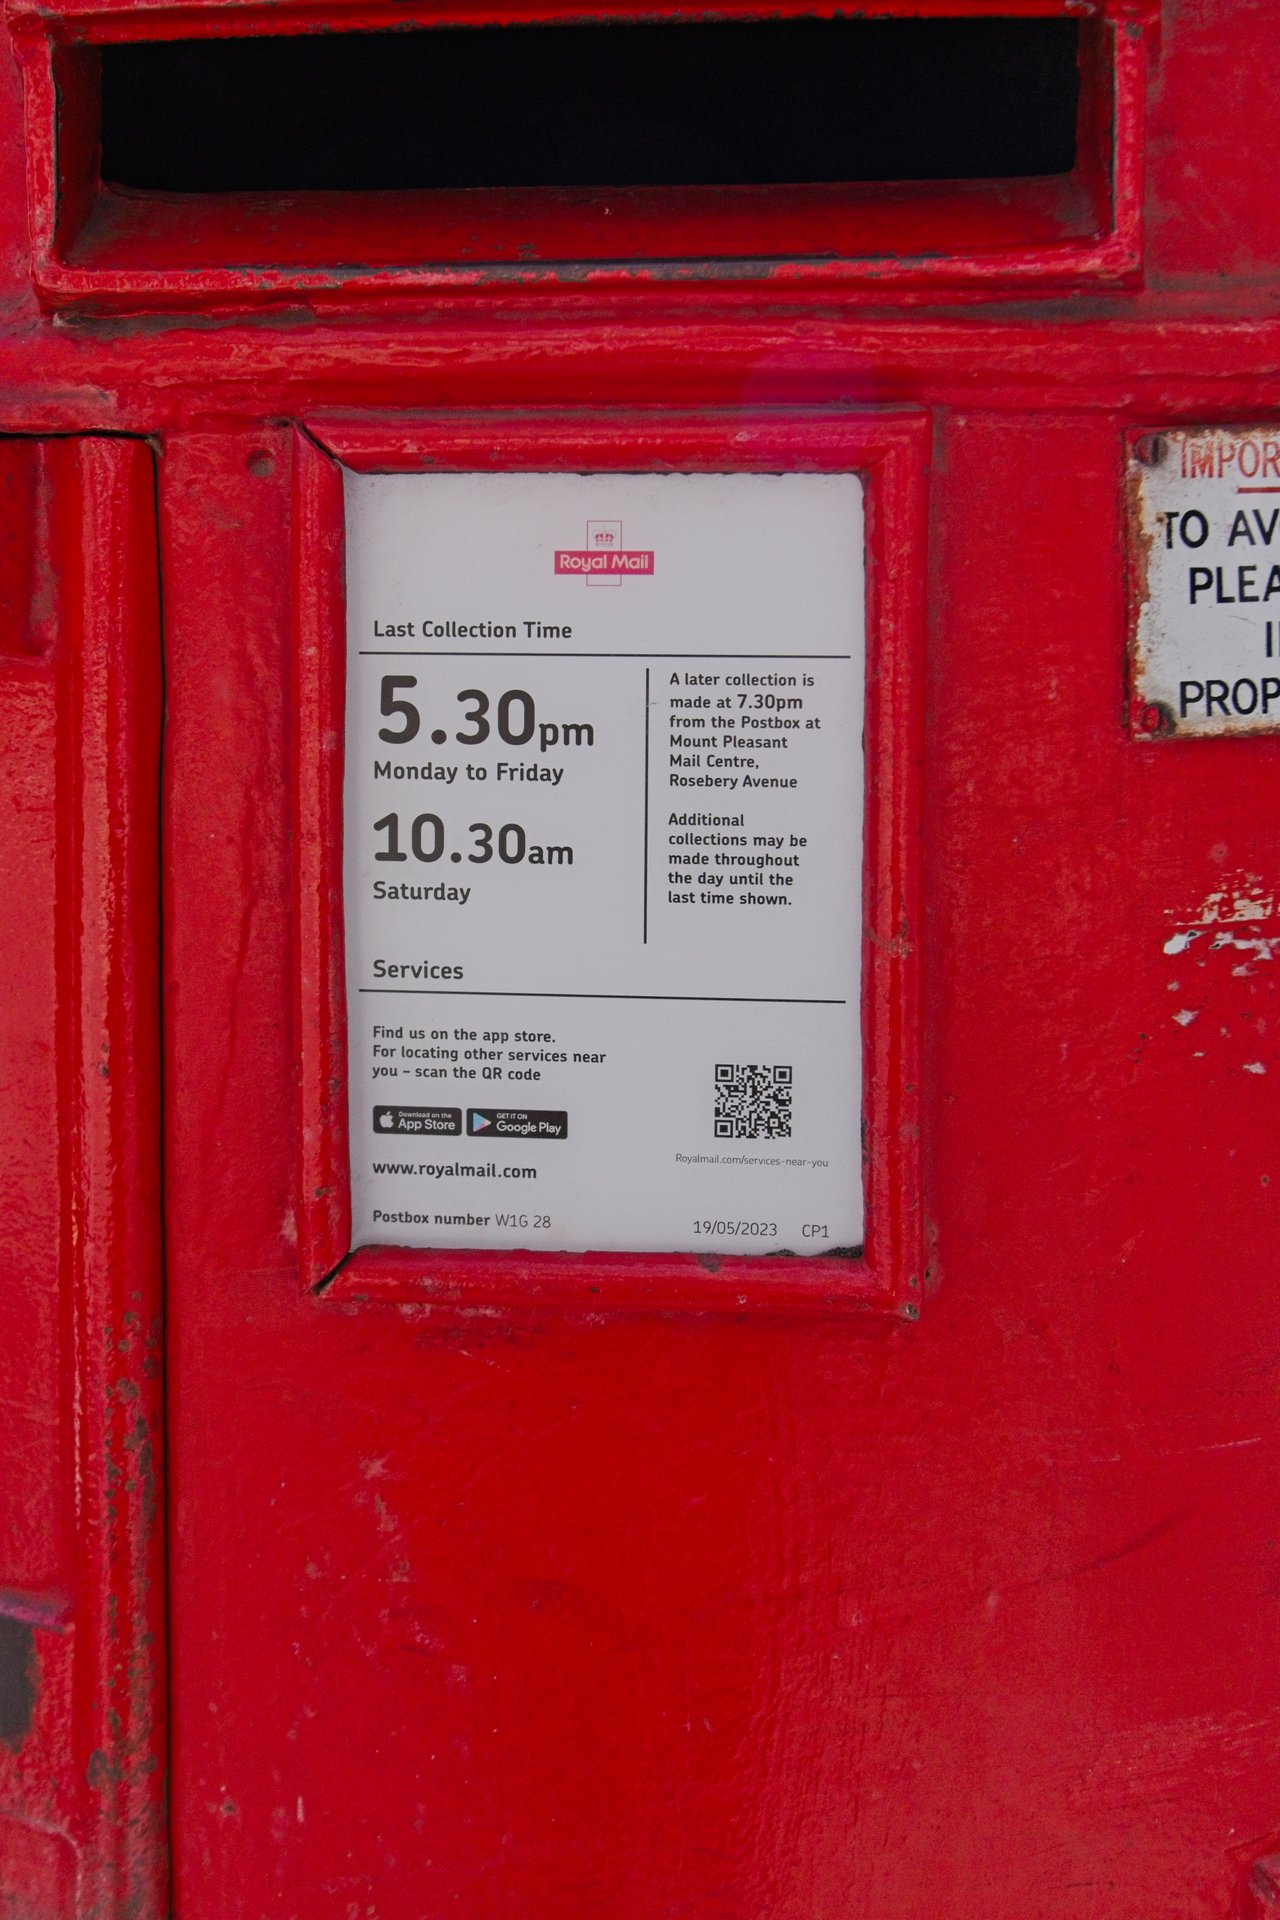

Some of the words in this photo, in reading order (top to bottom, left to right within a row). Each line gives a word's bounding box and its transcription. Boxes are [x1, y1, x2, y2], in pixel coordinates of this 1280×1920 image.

[1181, 441, 1280, 480] IMPOR
[1163, 509, 1209, 549] TO
[1227, 508, 1280, 547] AV
[559, 553, 608, 572] Royal
[611, 553, 649, 570] Mail
[1189, 564, 1280, 605] PLEA
[374, 620, 415, 638] Last
[423, 620, 516, 639] Collection
[523, 621, 572, 639] Time
[669, 672, 680, 686] A
[685, 672, 720, 686] later
[725, 673, 797, 687] collection
[802, 673, 815, 687] is
[669, 696, 711, 709] made
[716, 697, 732, 709] at
[736, 693, 803, 712] 7.30pm
[1179, 677, 1280, 719] PROP
[377, 674, 595, 754] 5.30pm
[669, 714, 705, 729] from
[711, 715, 735, 729] the
[741, 715, 800, 730] Postbox
[805, 717, 821, 730] at
[669, 734, 717, 749] Mount
[723, 734, 788, 749] Pleasant
[669, 754, 701, 768] Mail
[706, 754, 760, 769] Centre,
[373, 761, 458, 784] Monday
[465, 764, 487, 781] to
[496, 762, 564, 786] Friday
[669, 774, 738, 790] Rosebery
[742, 774, 798, 788] Avenue
[668, 812, 745, 827] Additional
[373, 812, 574, 865] 10.30am
[668, 832, 748, 847] collections
[753, 836, 784, 850] may
[789, 834, 808, 848] be
[668, 852, 710, 866] made
[714, 853, 800, 869] throughout
[668, 871, 692, 885] the
[697, 872, 724, 887] day
[729, 872, 764, 886] until
[769, 873, 794, 887] the
[373, 880, 471, 905] Saturday
[668, 890, 695, 904] last
[700, 891, 734, 905] time
[739, 892, 793, 906] shown.
[373, 959, 464, 980] Services
[373, 1025, 404, 1039] Find
[409, 1029, 426, 1040] us
[430, 1030, 449, 1041] on
[453, 1027, 478, 1041] the
[482, 1031, 509, 1044] app
[514, 1030, 556, 1044] store.
[373, 1045, 397, 1058] For
[401, 1046, 459, 1062] locating
[464, 1047, 504, 1061] other
[508, 1049, 568, 1063] services
[573, 1052, 607, 1064] near
[372, 1066, 398, 1079] you
[415, 1068, 448, 1079] scan
[453, 1066, 477, 1080] the
[482, 1067, 503, 1081] QR
[508, 1068, 541, 1081] code
[398, 1111, 430, 1119] Download
[496, 1112, 510, 1120] GET
[517, 1113, 528, 1121] ON
[398, 1118, 422, 1132] App
[424, 1119, 456, 1131] Store
[496, 1121, 537, 1135] Google
[538, 1122, 562, 1136] Play
[675, 1153, 829, 1169] Royalmail.com/services-near-you
[372, 1162, 537, 1180] www.royalmail.com
[373, 1209, 430, 1224] Postbox
[434, 1212, 491, 1227] number
[495, 1213, 529, 1228] W1G
[533, 1215, 552, 1229] 28
[693, 1220, 778, 1236] 19/05/2023
[801, 1224, 830, 1239] CP1
